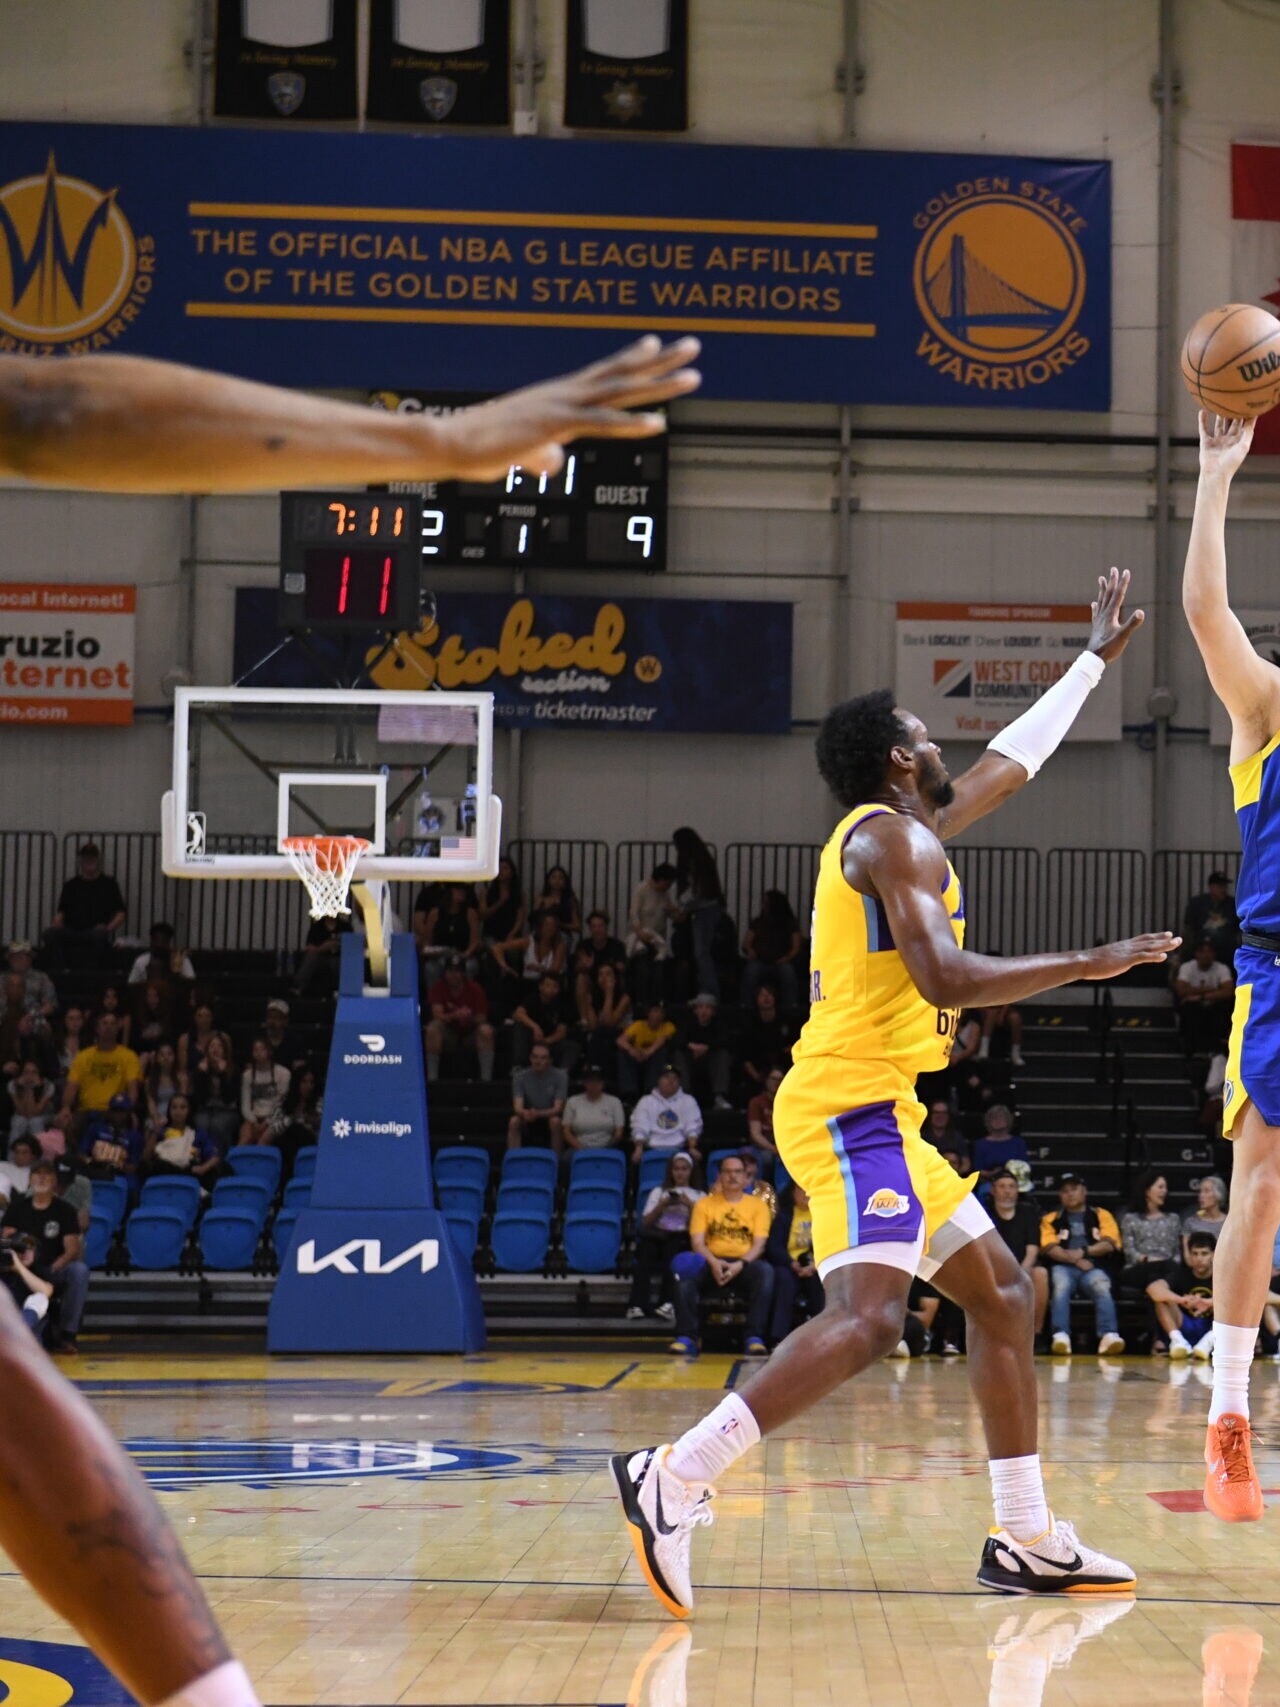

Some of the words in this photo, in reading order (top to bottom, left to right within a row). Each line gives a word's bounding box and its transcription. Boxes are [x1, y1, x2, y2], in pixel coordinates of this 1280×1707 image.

[912, 177, 1009, 230] GOLDEN
[1019, 181, 1088, 235] STATE
[191, 229, 257, 256] THE
[269, 231, 428, 261] OFFICIAL
[440, 237, 513, 263] NBA
[524, 240, 548, 265] G
[559, 241, 694, 270] LEAGUE
[704, 247, 875, 276] AFFILIATE
[66, 234, 156, 357] WARRIORS
[224, 268, 273, 294] OF
[287, 270, 355, 296] THE
[368, 272, 518, 301] GOLDEN
[531, 278, 638, 305] STATE
[651, 282, 842, 312] WARRIORS
[915, 331, 1092, 391] WARRIORS
[389, 481, 438, 500] HOME
[595, 485, 649, 506] GUEST
[328, 503, 404, 536] 7:11
[517, 523, 528, 553] 1
[626, 515, 654, 558] 9
[0, 591, 37, 606] ocal
[43, 592, 125, 608] Internet!
[337, 556, 392, 615] 11
[0, 629, 101, 659] ruzio
[365, 599, 627, 691] Stoked
[3, 659, 130, 689] ternet
[521, 669, 611, 694] section
[975, 660, 1022, 682] WEST
[0, 705, 68, 721] io.com
[533, 700, 657, 721] ticketmaster
[344, 1055, 402, 1065] DOORDASH
[354, 1120, 412, 1137] invisalign
